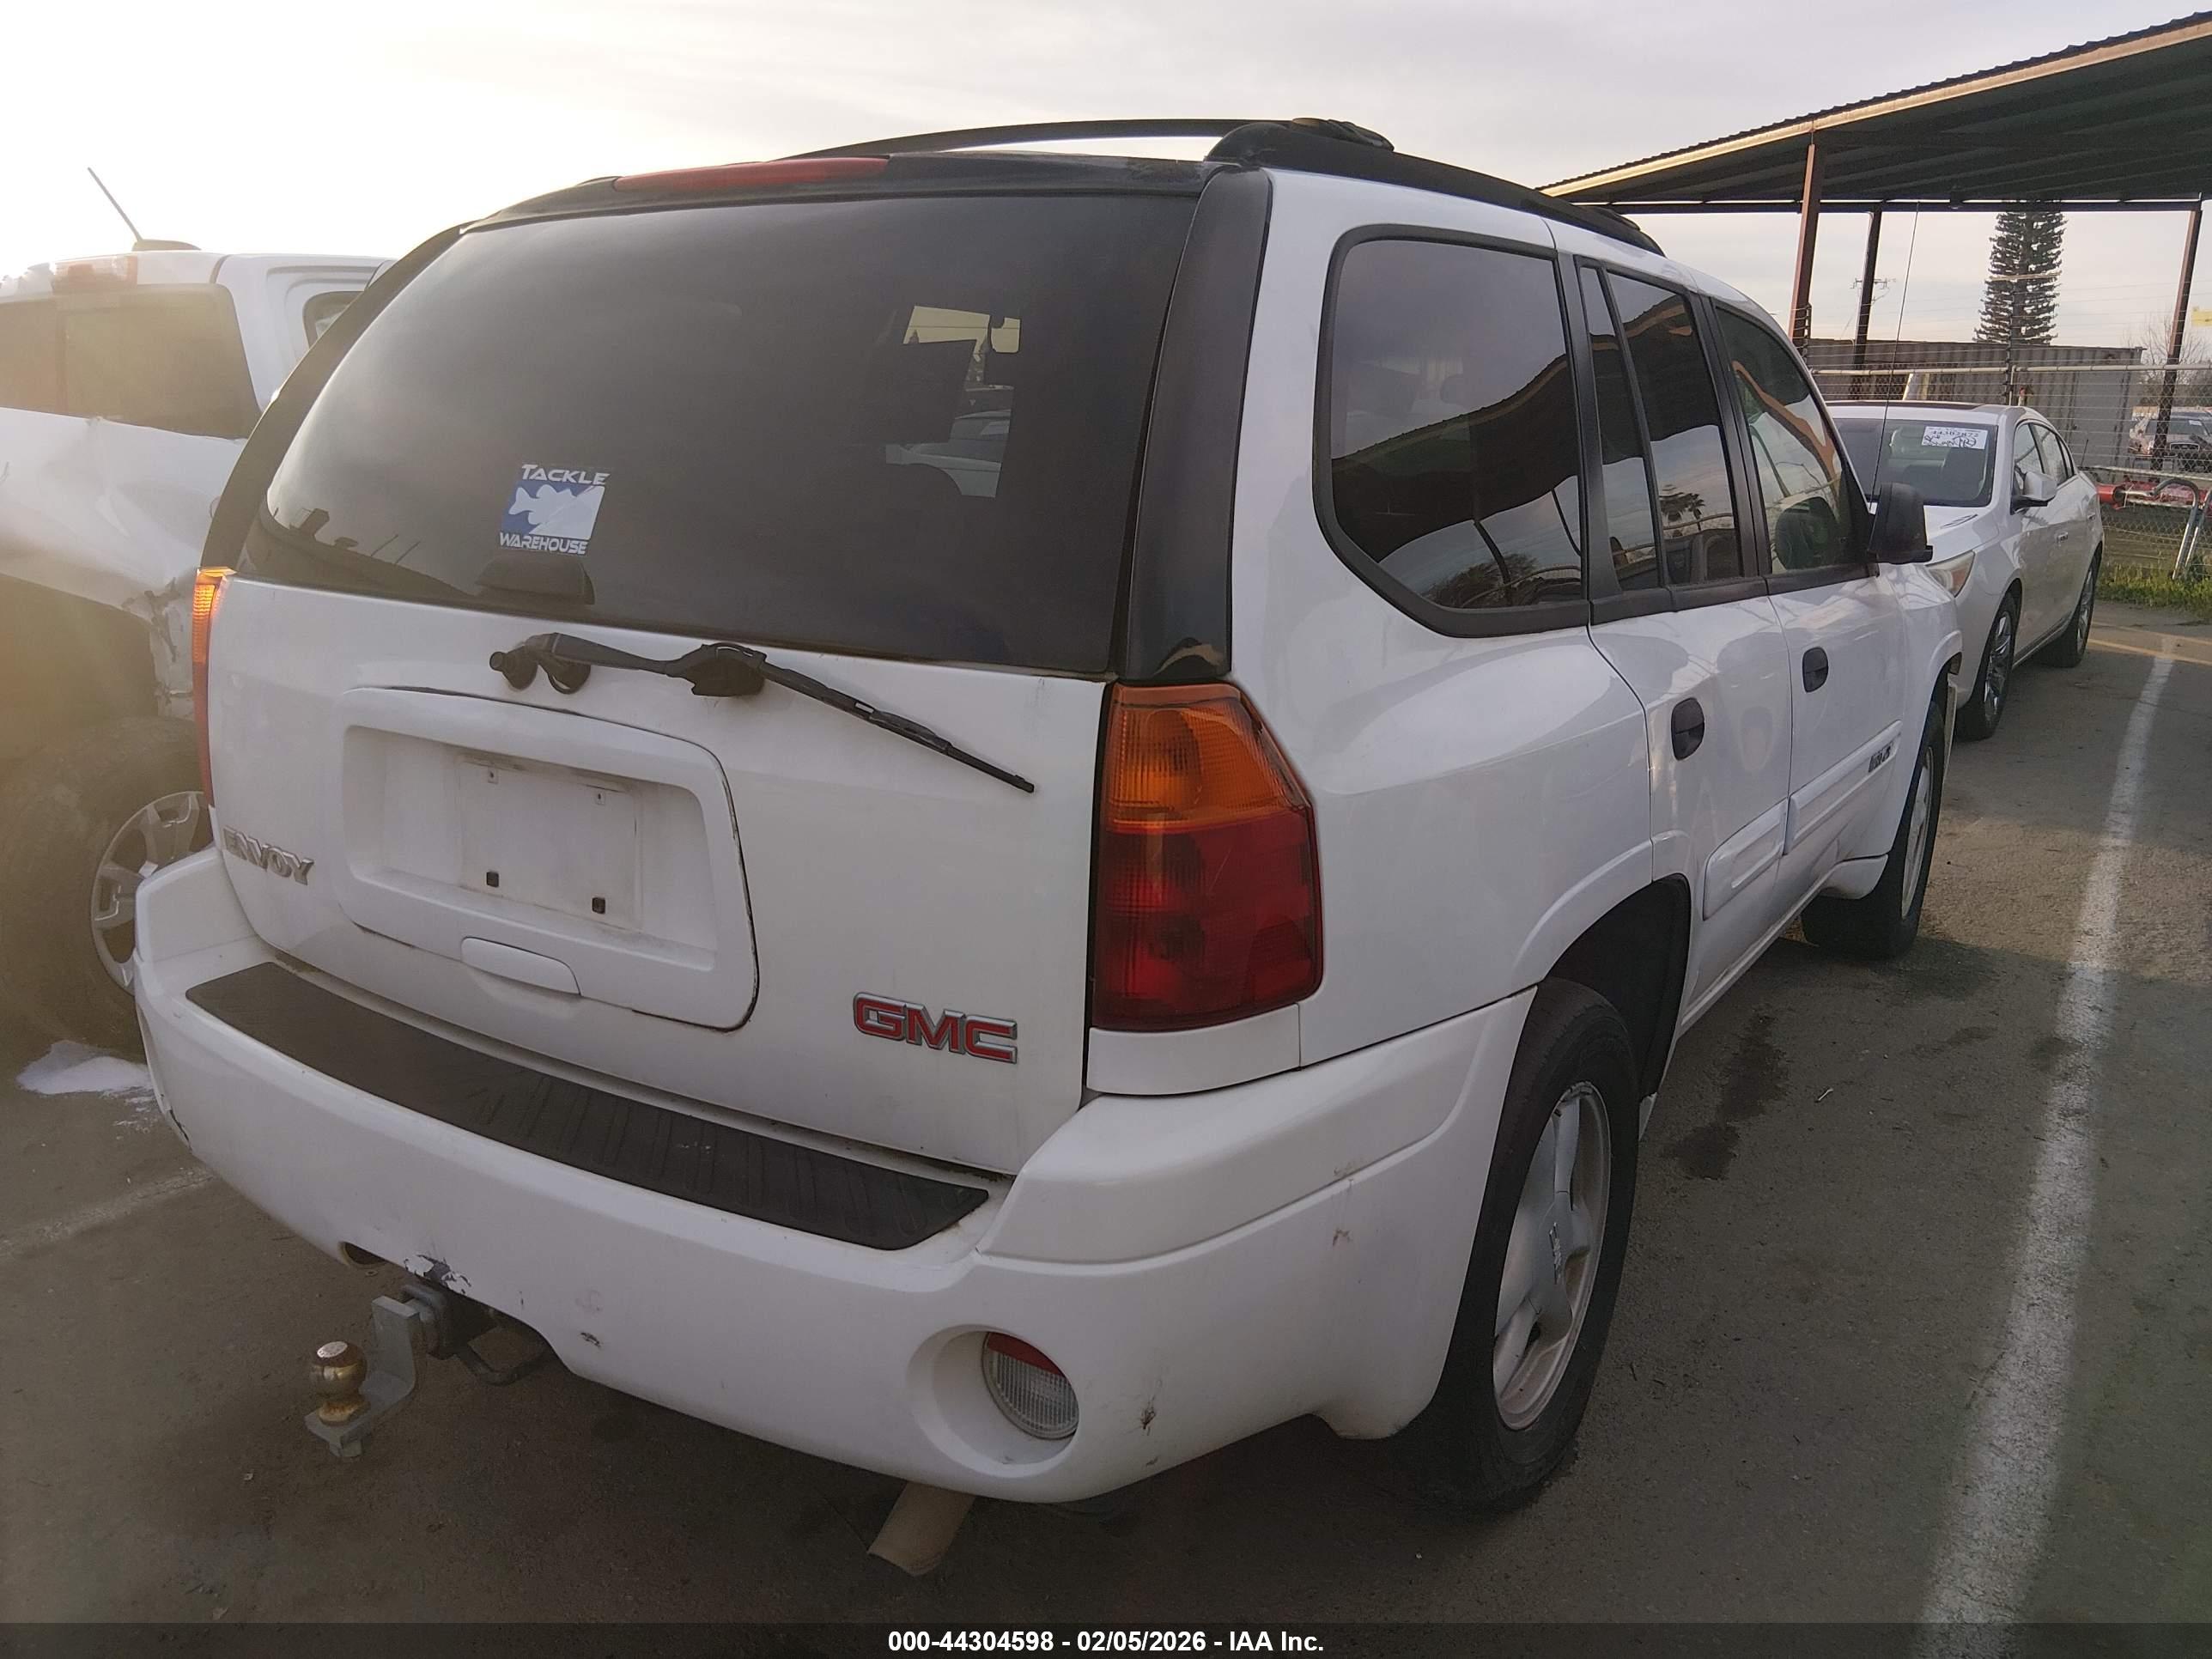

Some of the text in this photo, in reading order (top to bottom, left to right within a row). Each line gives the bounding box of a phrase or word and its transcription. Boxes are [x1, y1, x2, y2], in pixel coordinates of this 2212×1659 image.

[521, 464, 611, 485] TACKLE
[499, 532, 588, 555] WAREHOUSE
[223, 825, 314, 885] ENVOY
[853, 992, 1017, 1064] GMC
